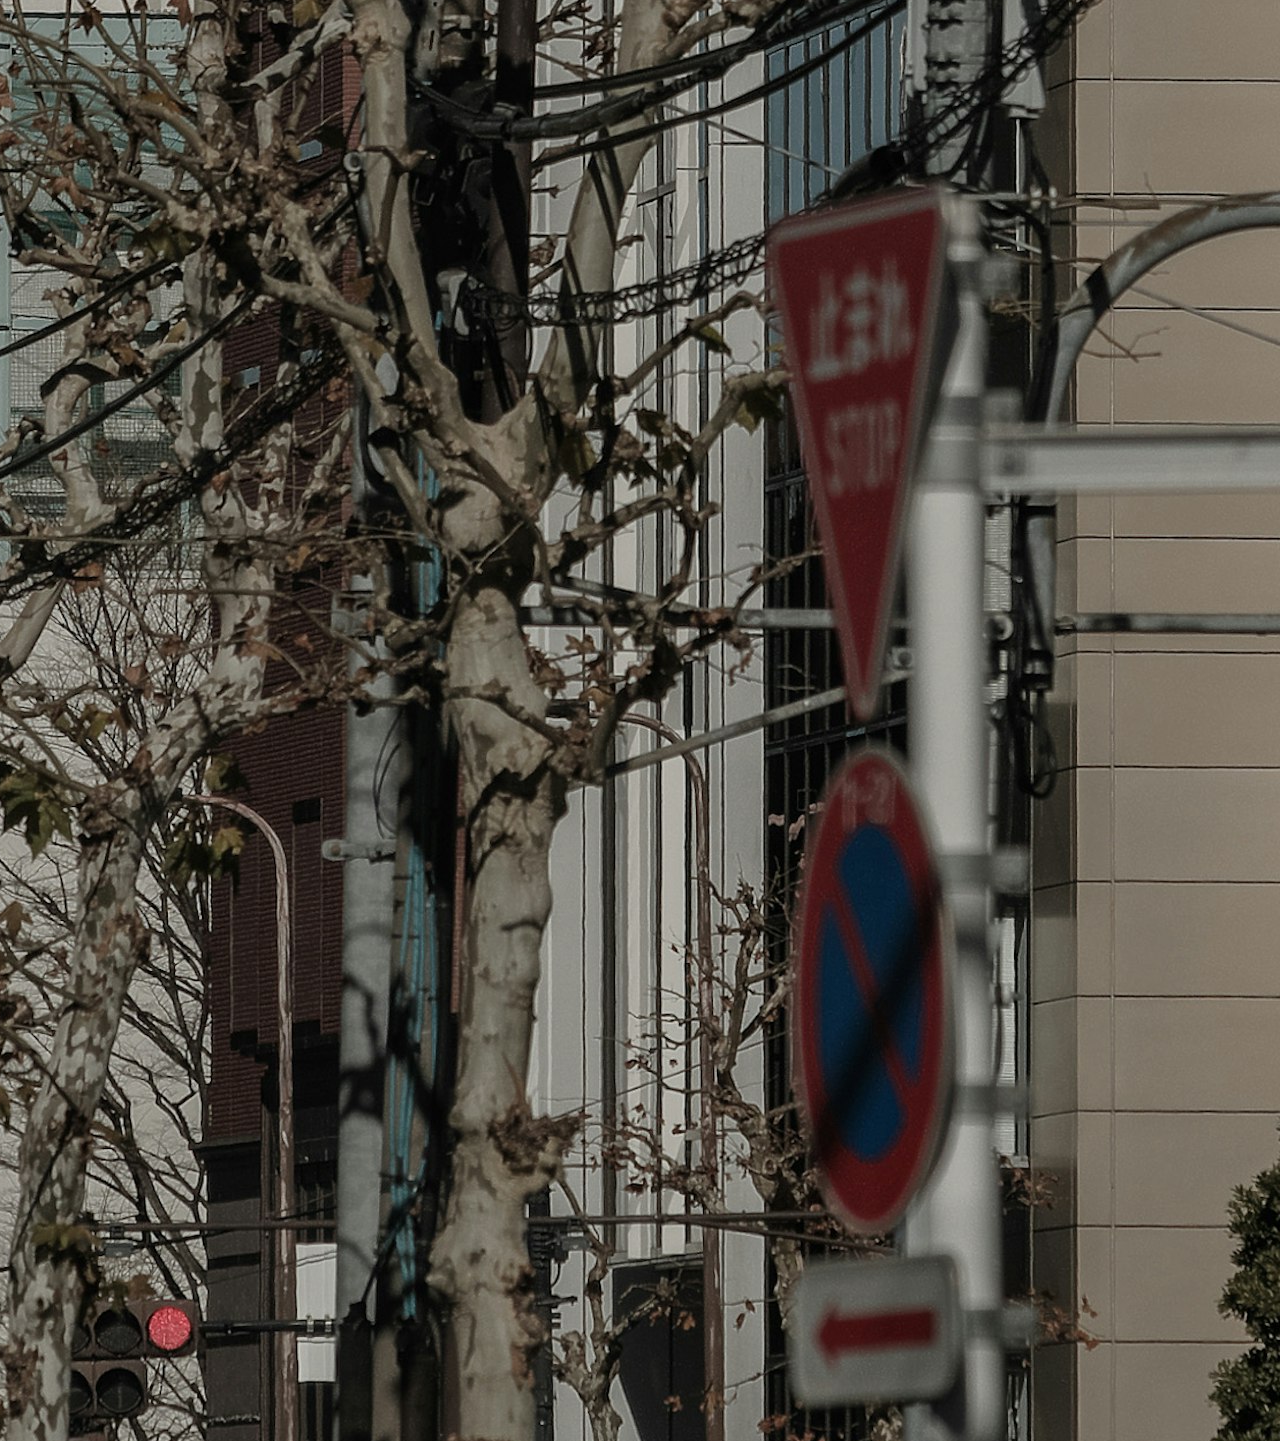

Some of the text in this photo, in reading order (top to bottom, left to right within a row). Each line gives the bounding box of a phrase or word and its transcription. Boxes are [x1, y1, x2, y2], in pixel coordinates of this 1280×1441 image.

[807, 255, 912, 382] 止まれ
[825, 397, 900, 496] STOP
